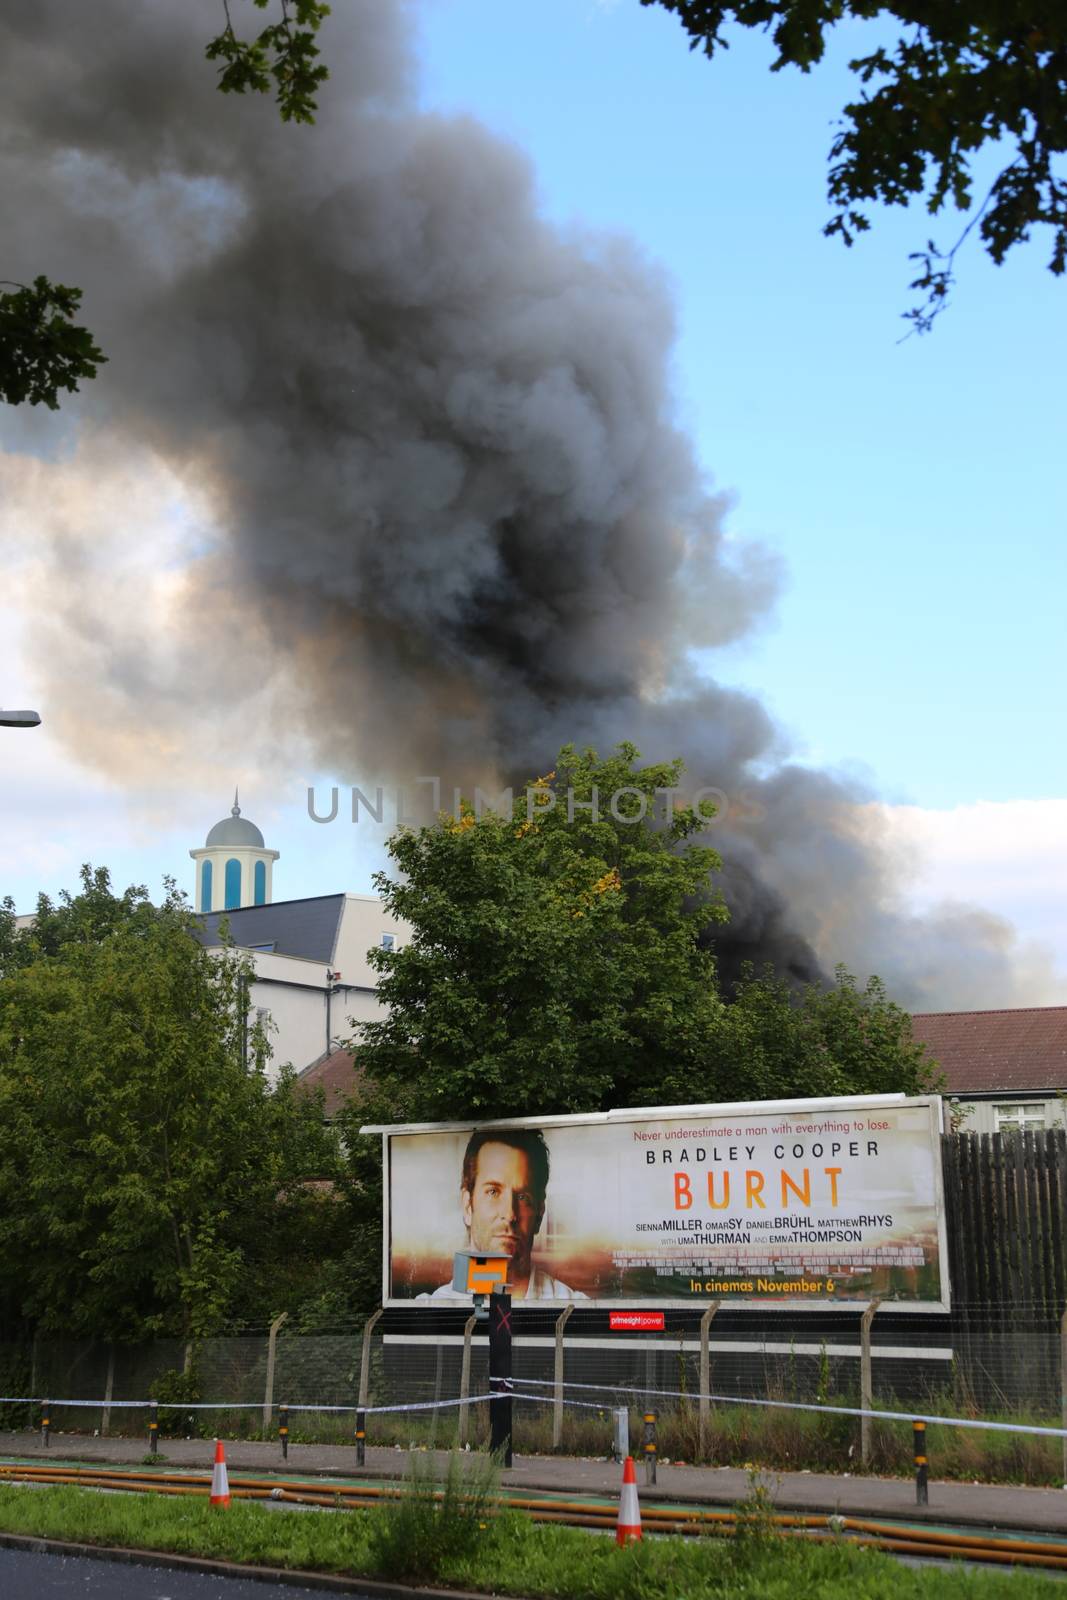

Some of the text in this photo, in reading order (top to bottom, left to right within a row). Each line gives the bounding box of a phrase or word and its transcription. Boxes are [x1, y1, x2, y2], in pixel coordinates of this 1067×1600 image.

[634, 1131, 661, 1141] Never
[665, 1127, 732, 1140] underestimate
[745, 1126, 768, 1136] man
[771, 1122, 792, 1134] with
[796, 1120, 850, 1135] everything
[854, 1120, 864, 1131] to
[646, 1141, 878, 1165] BRADLEY COOPER
[673, 1167, 843, 1211] BURNT
[690, 1278, 834, 1292] In cinemas November 6
